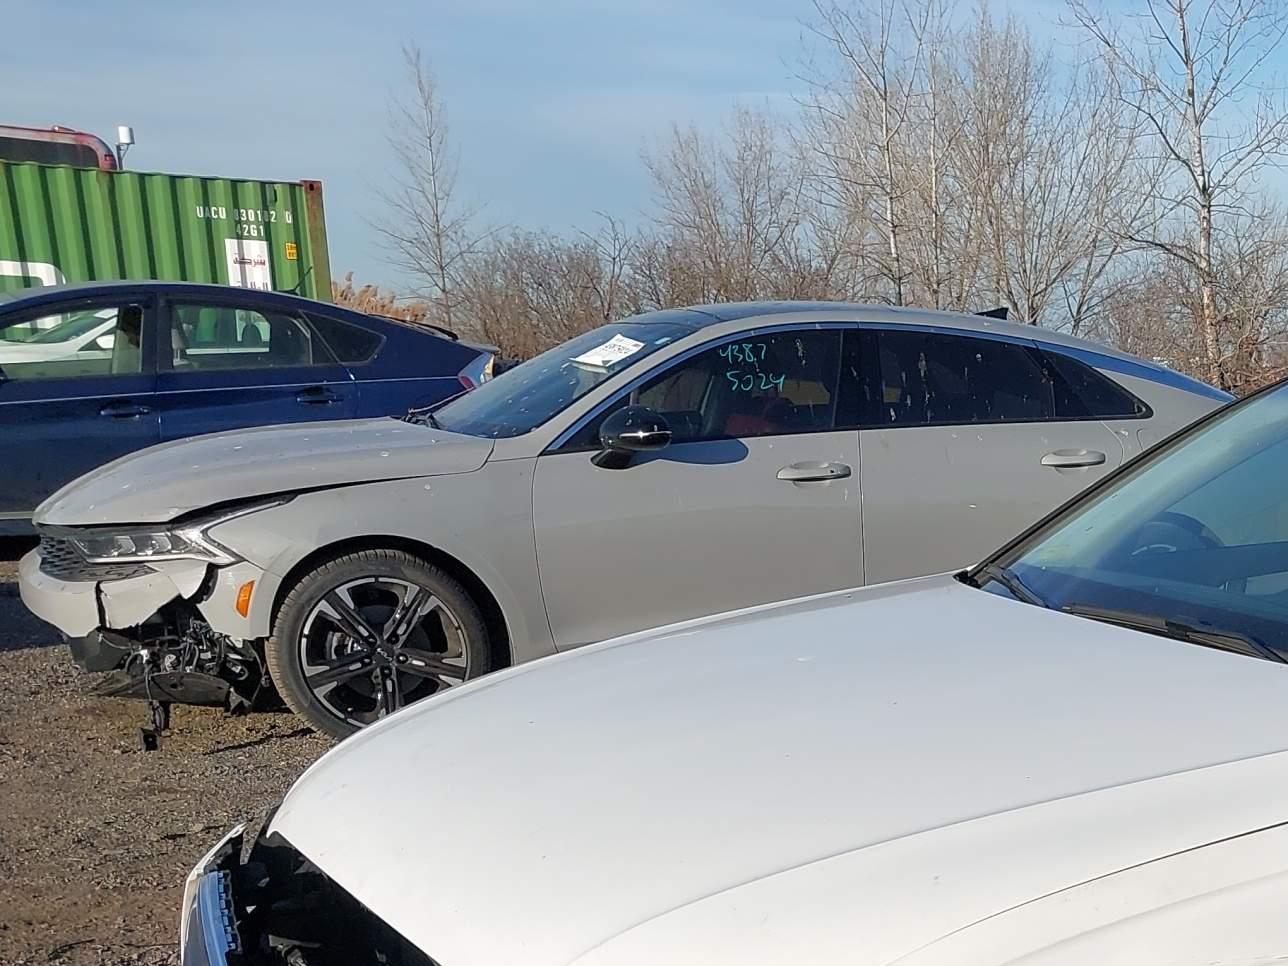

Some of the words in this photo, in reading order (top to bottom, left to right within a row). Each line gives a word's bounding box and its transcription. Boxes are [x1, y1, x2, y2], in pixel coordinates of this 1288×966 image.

[196, 206, 227, 219] UACU
[236, 223, 264, 237] 42G1
[719, 343, 767, 364] 4387
[726, 370, 786, 393] 5024
